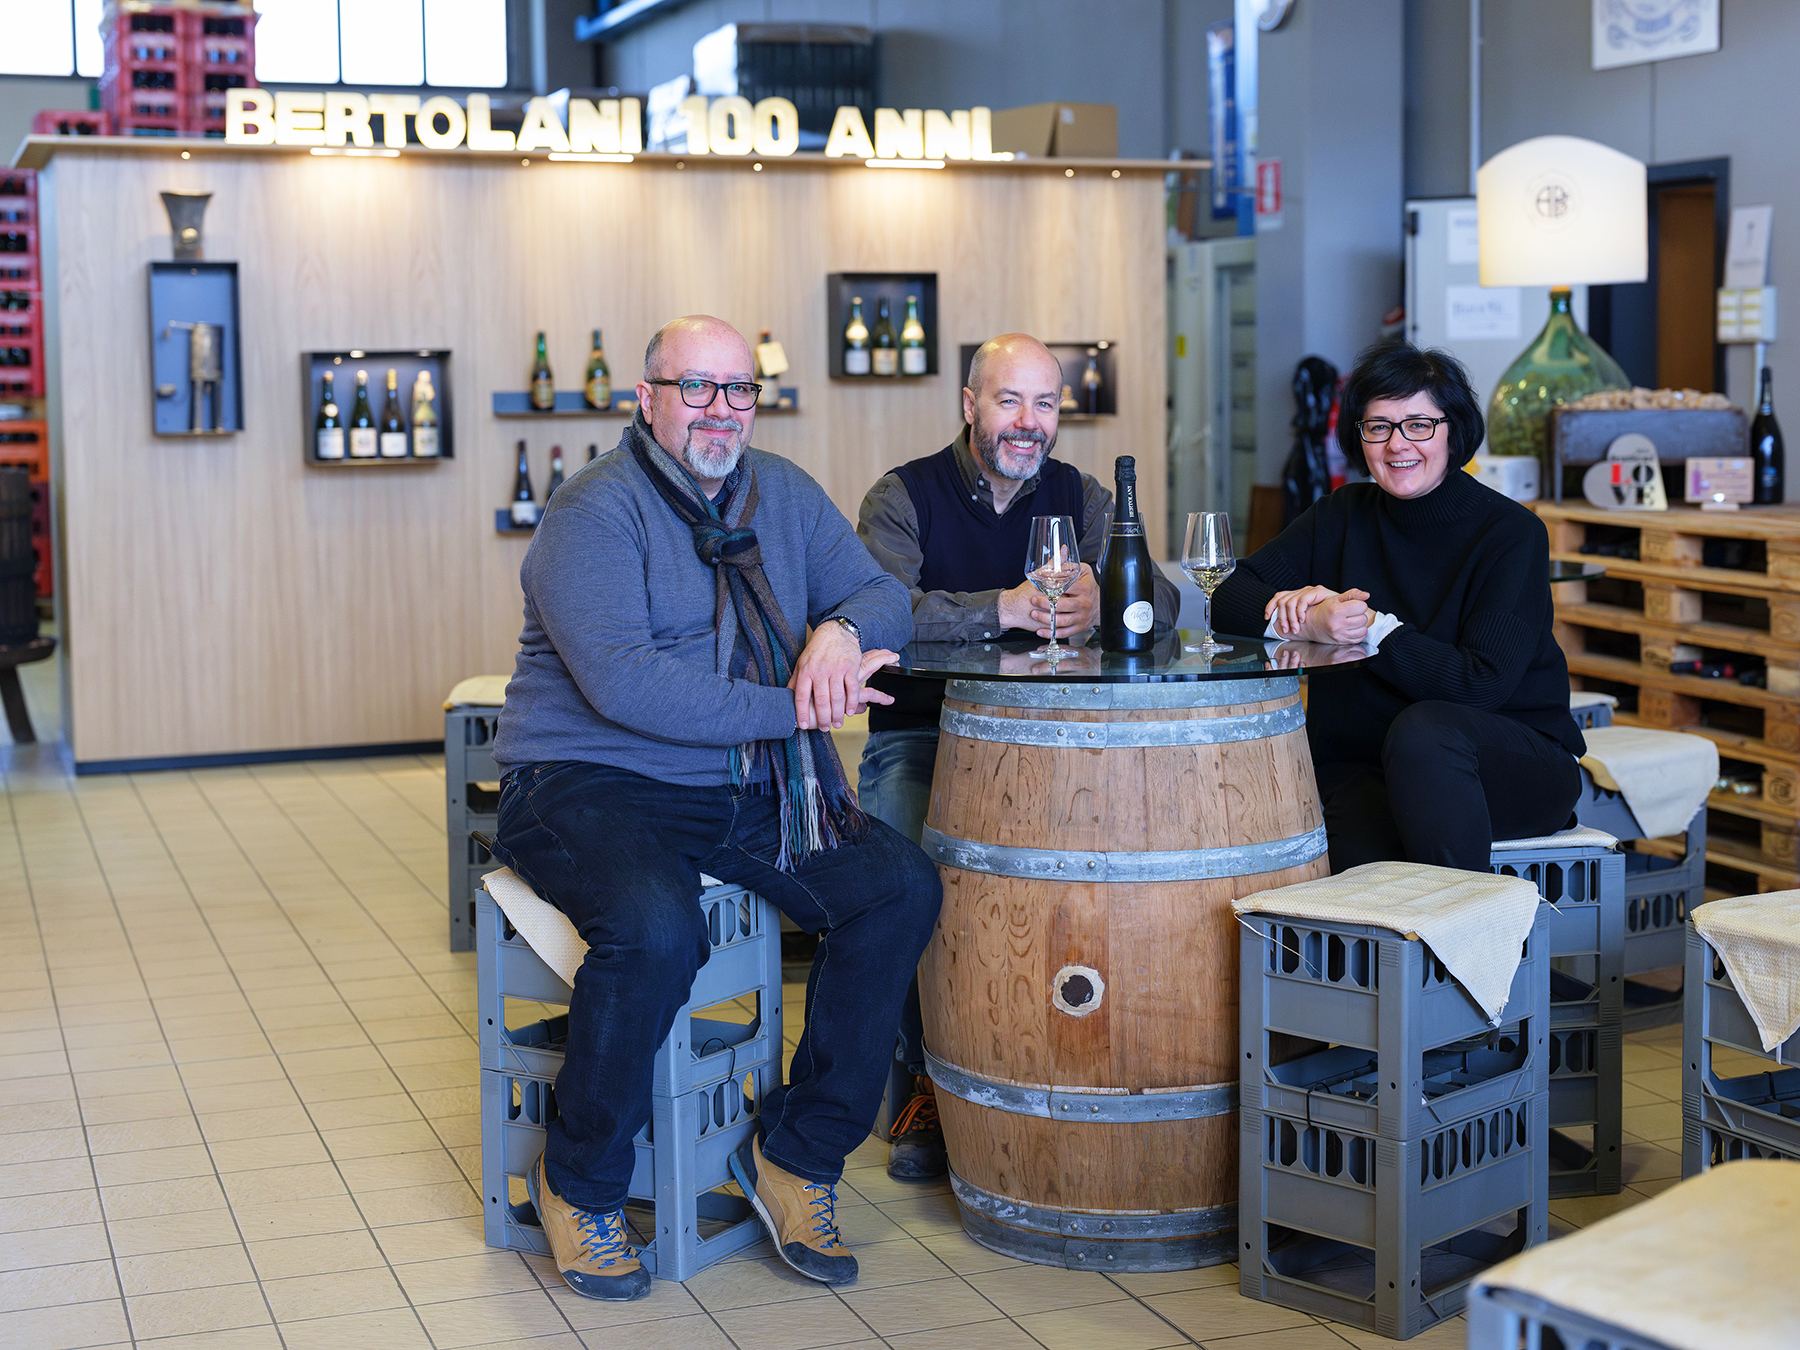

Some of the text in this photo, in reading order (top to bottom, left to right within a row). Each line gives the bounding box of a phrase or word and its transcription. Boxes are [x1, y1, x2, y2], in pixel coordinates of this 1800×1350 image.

[225, 88, 993, 161] BERTOLANI 100 ANNI
